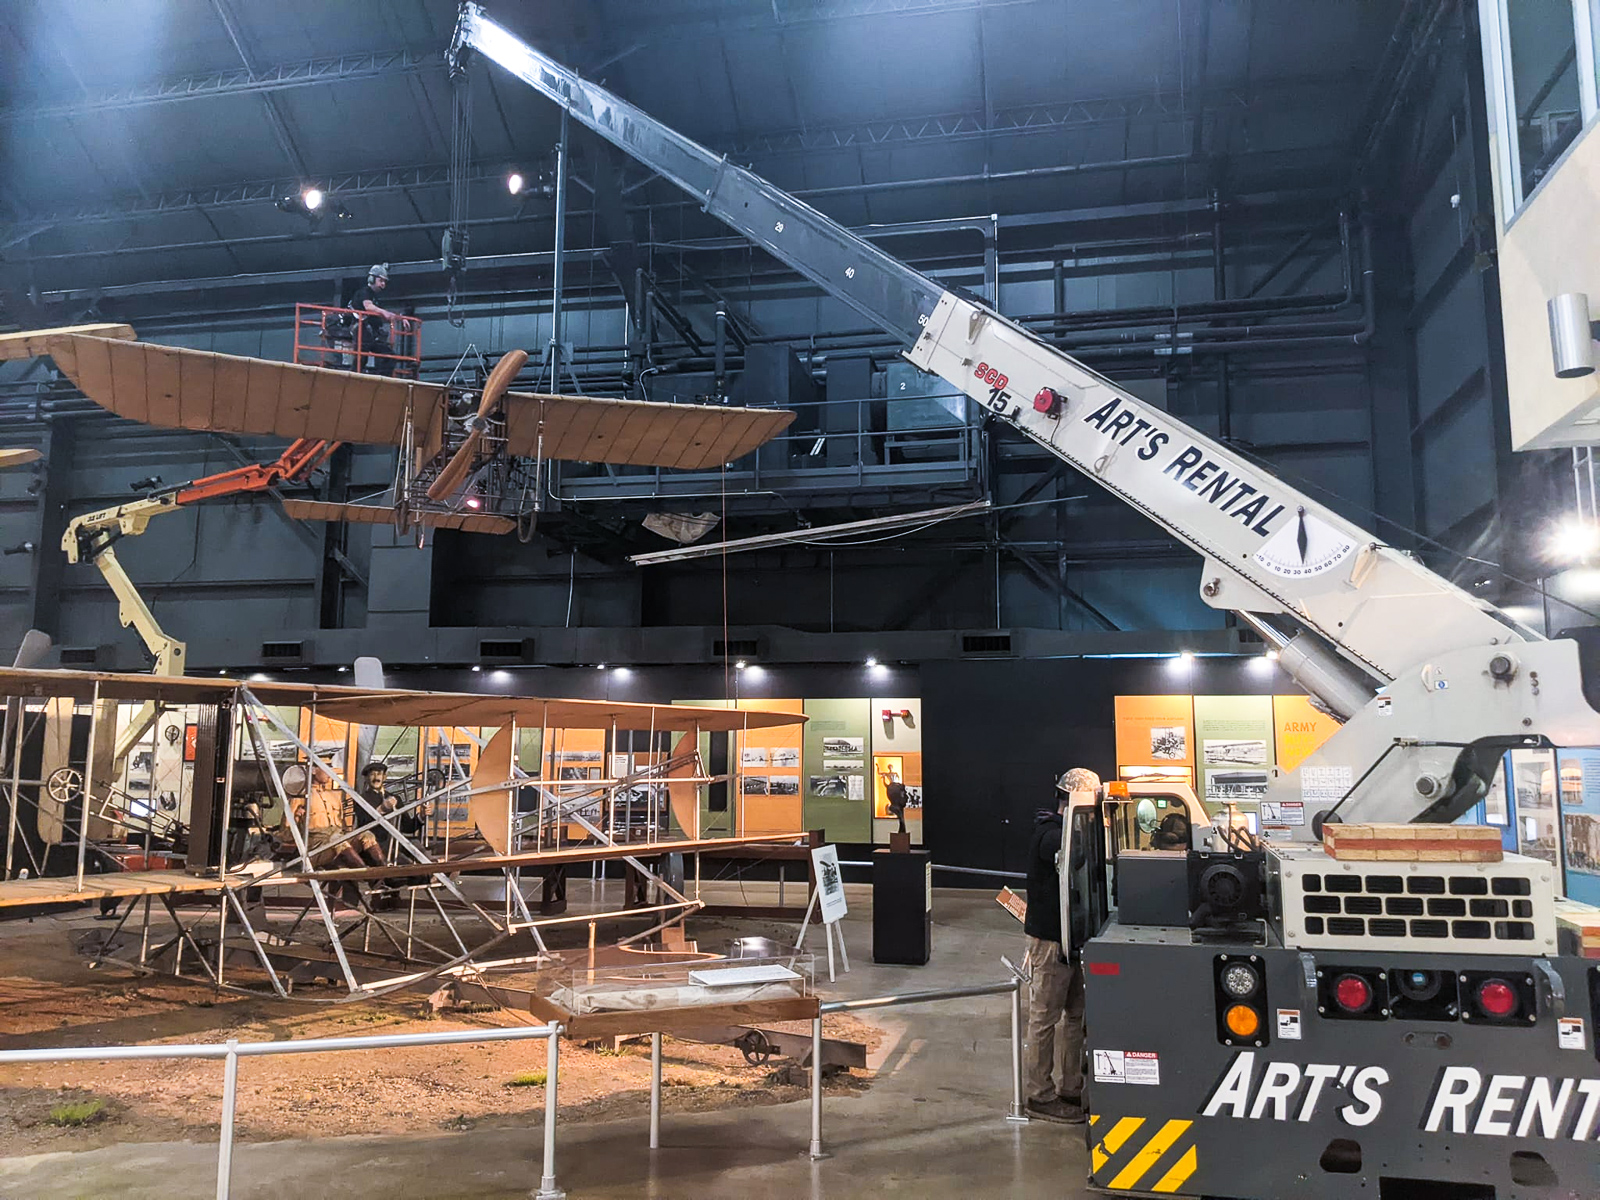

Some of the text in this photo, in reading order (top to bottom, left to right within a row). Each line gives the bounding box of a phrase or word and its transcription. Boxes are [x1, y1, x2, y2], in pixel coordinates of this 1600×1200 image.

[845, 266, 855, 279] 40
[918, 313, 929, 327] 50
[900, 382, 906, 390] 2
[974, 361, 1009, 391] SCD
[987, 388, 1012, 413] 15
[1083, 397, 1286, 538] ART'S RENTAL
[1324, 560, 1333, 568] 60
[1333, 553, 1342, 562] 70
[1342, 544, 1350, 553] 80
[1284, 721, 1317, 732] ARMY
[1201, 1051, 1600, 1142] ART'S RENT
